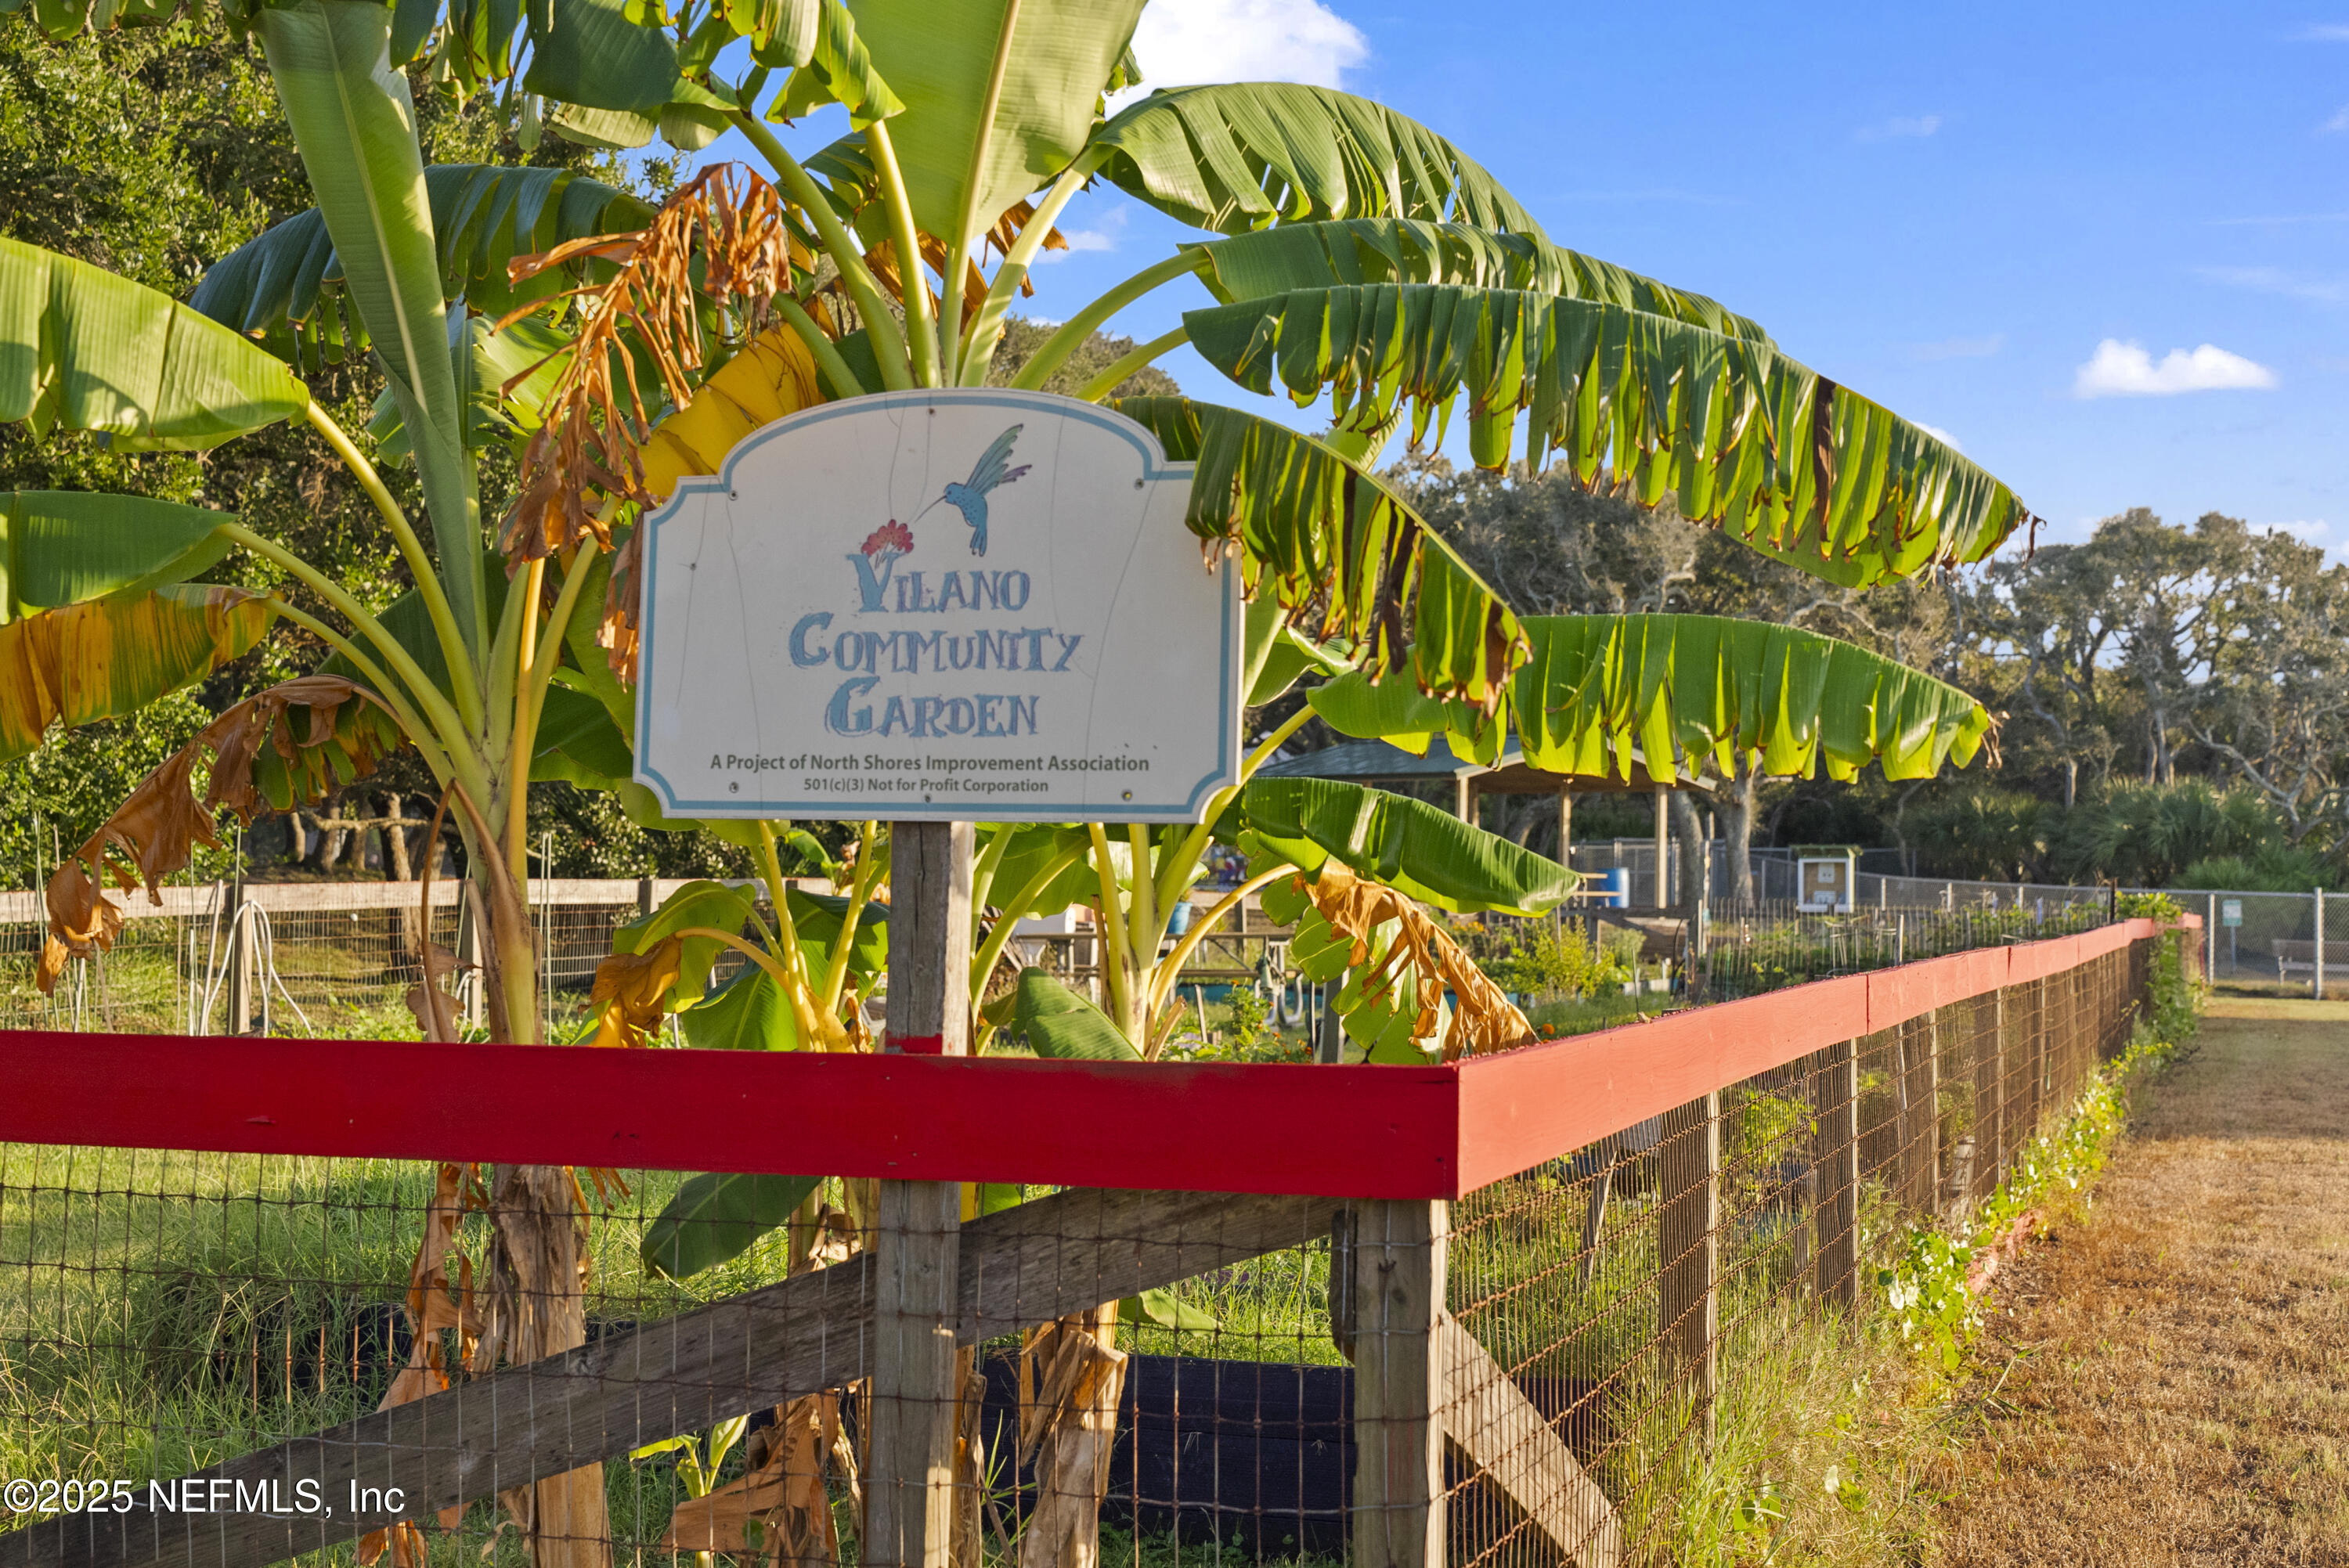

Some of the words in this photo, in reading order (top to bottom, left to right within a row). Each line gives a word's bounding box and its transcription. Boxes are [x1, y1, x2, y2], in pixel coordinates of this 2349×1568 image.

[846, 552, 1030, 614] VILANO
[788, 611, 1084, 674] COMMUNITY
[825, 676, 1040, 737] GARDEN
[710, 754, 722, 770] A
[727, 754, 785, 773] Project
[789, 754, 807, 770] of
[810, 755, 859, 770] North
[864, 755, 922, 770] Shores
[926, 755, 1043, 774] Improvement
[1048, 755, 1149, 771] Association
[803, 778, 864, 792] 501(c)(3)
[868, 778, 893, 791] Not
[897, 777, 917, 791] for
[920, 778, 959, 791] Profit
[962, 778, 1048, 795] Corporation
